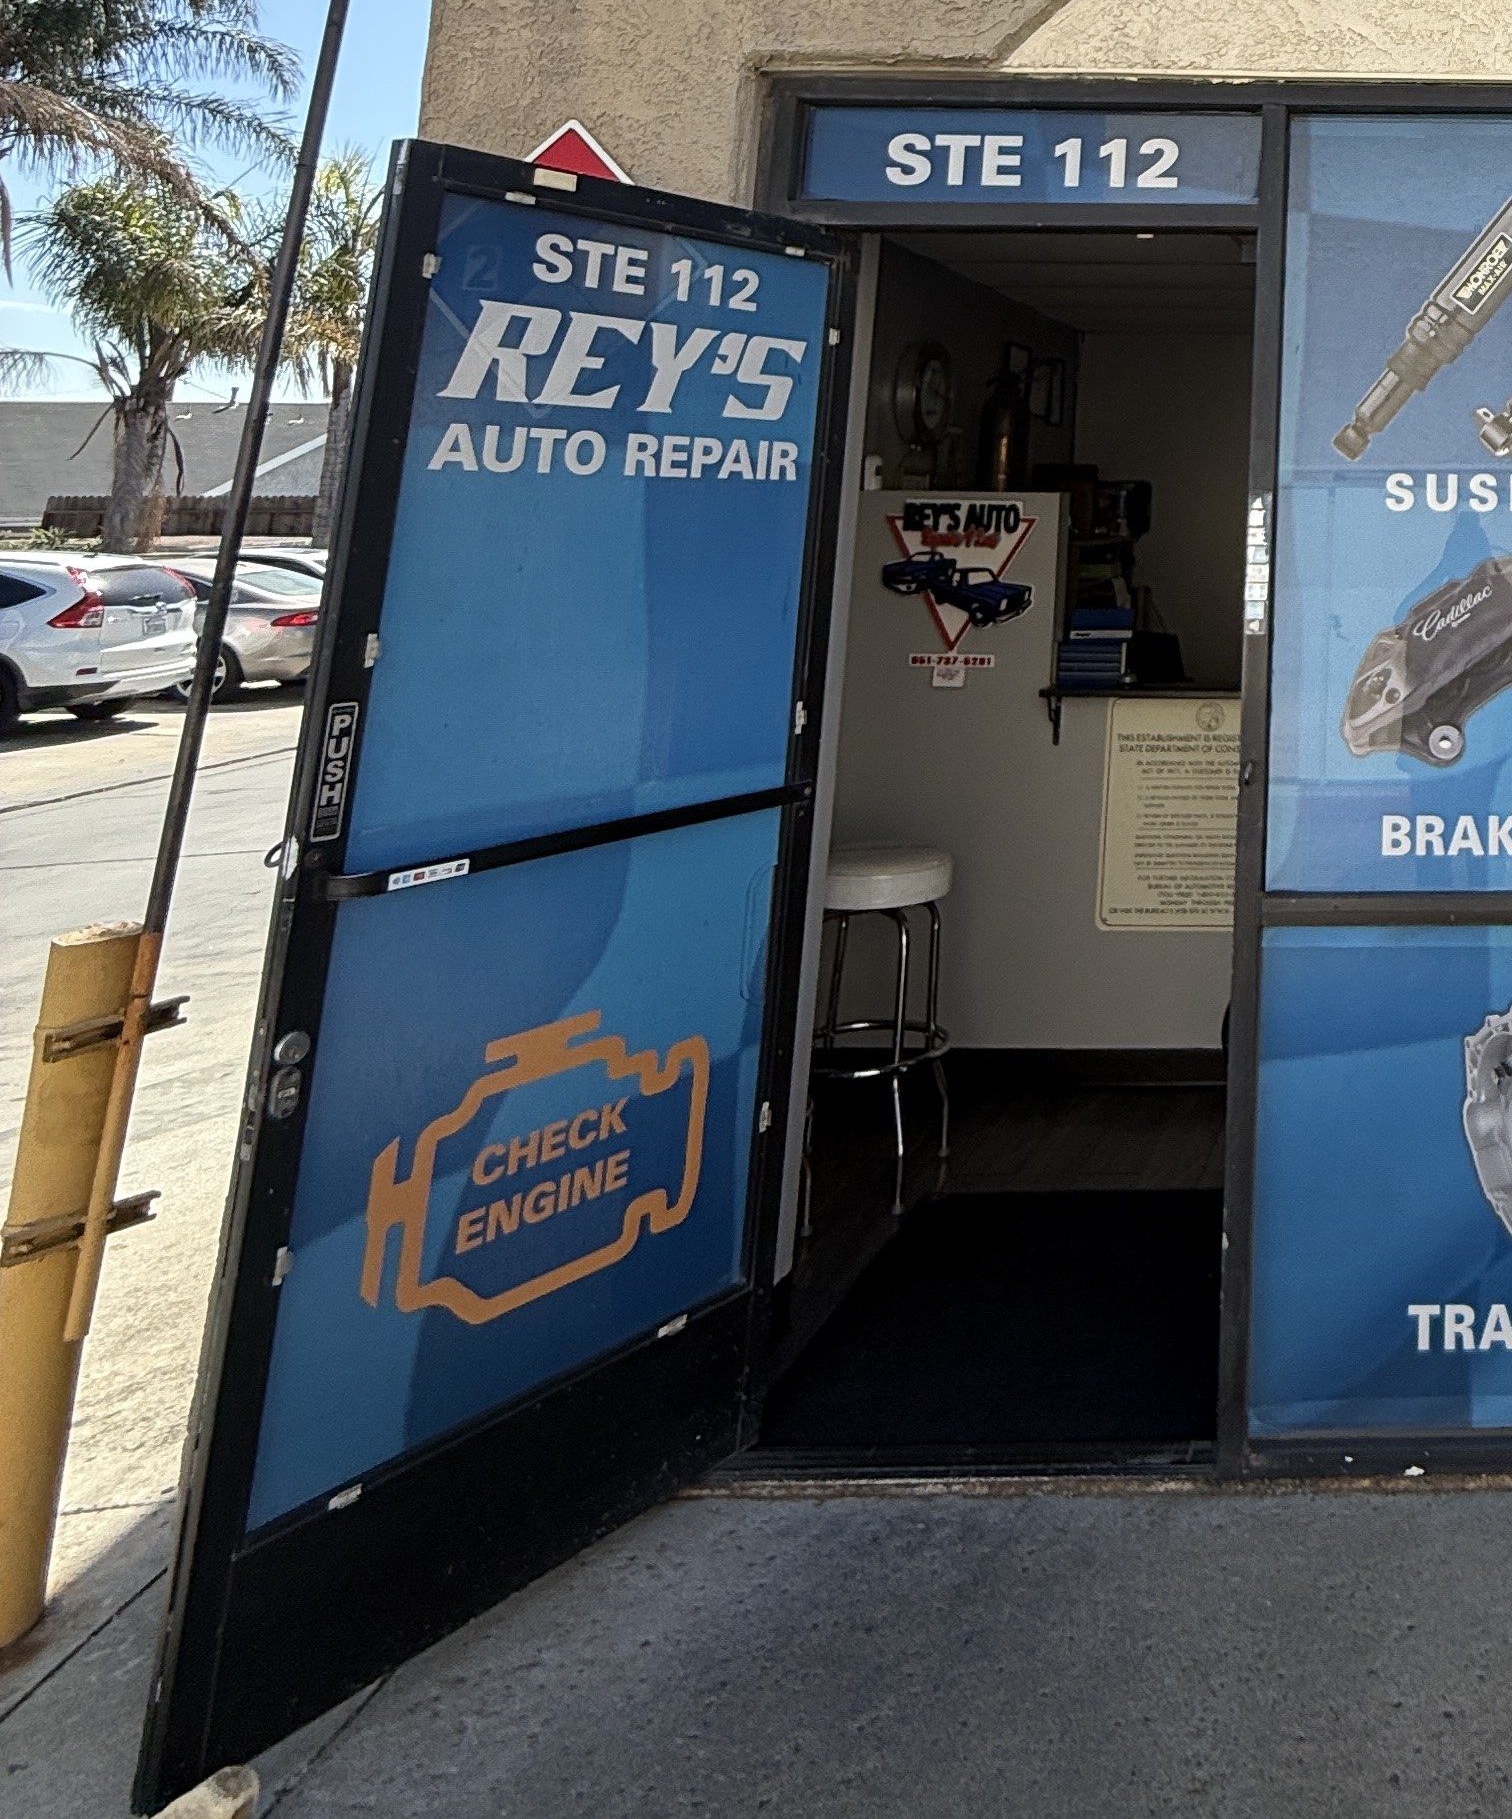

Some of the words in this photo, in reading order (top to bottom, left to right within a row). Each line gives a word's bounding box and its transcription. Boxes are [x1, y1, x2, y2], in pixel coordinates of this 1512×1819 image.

[885, 132, 1023, 186] STE
[1054, 137, 1180, 188] 112
[532, 233, 649, 296] STE
[670, 259, 761, 312] 112
[436, 298, 808, 421] REY'S
[427, 422, 607, 475] AUTO
[623, 432, 798, 482] REPAIR
[963, 503, 1021, 534] AUTO
[1413, 585, 1493, 641] Cadillac
[319, 714, 352, 806] PUSH
[1145, 744, 1200, 753] DEPARTMENT
[472, 1098, 629, 1186] CHECK
[453, 1148, 631, 1256] ENGINE
